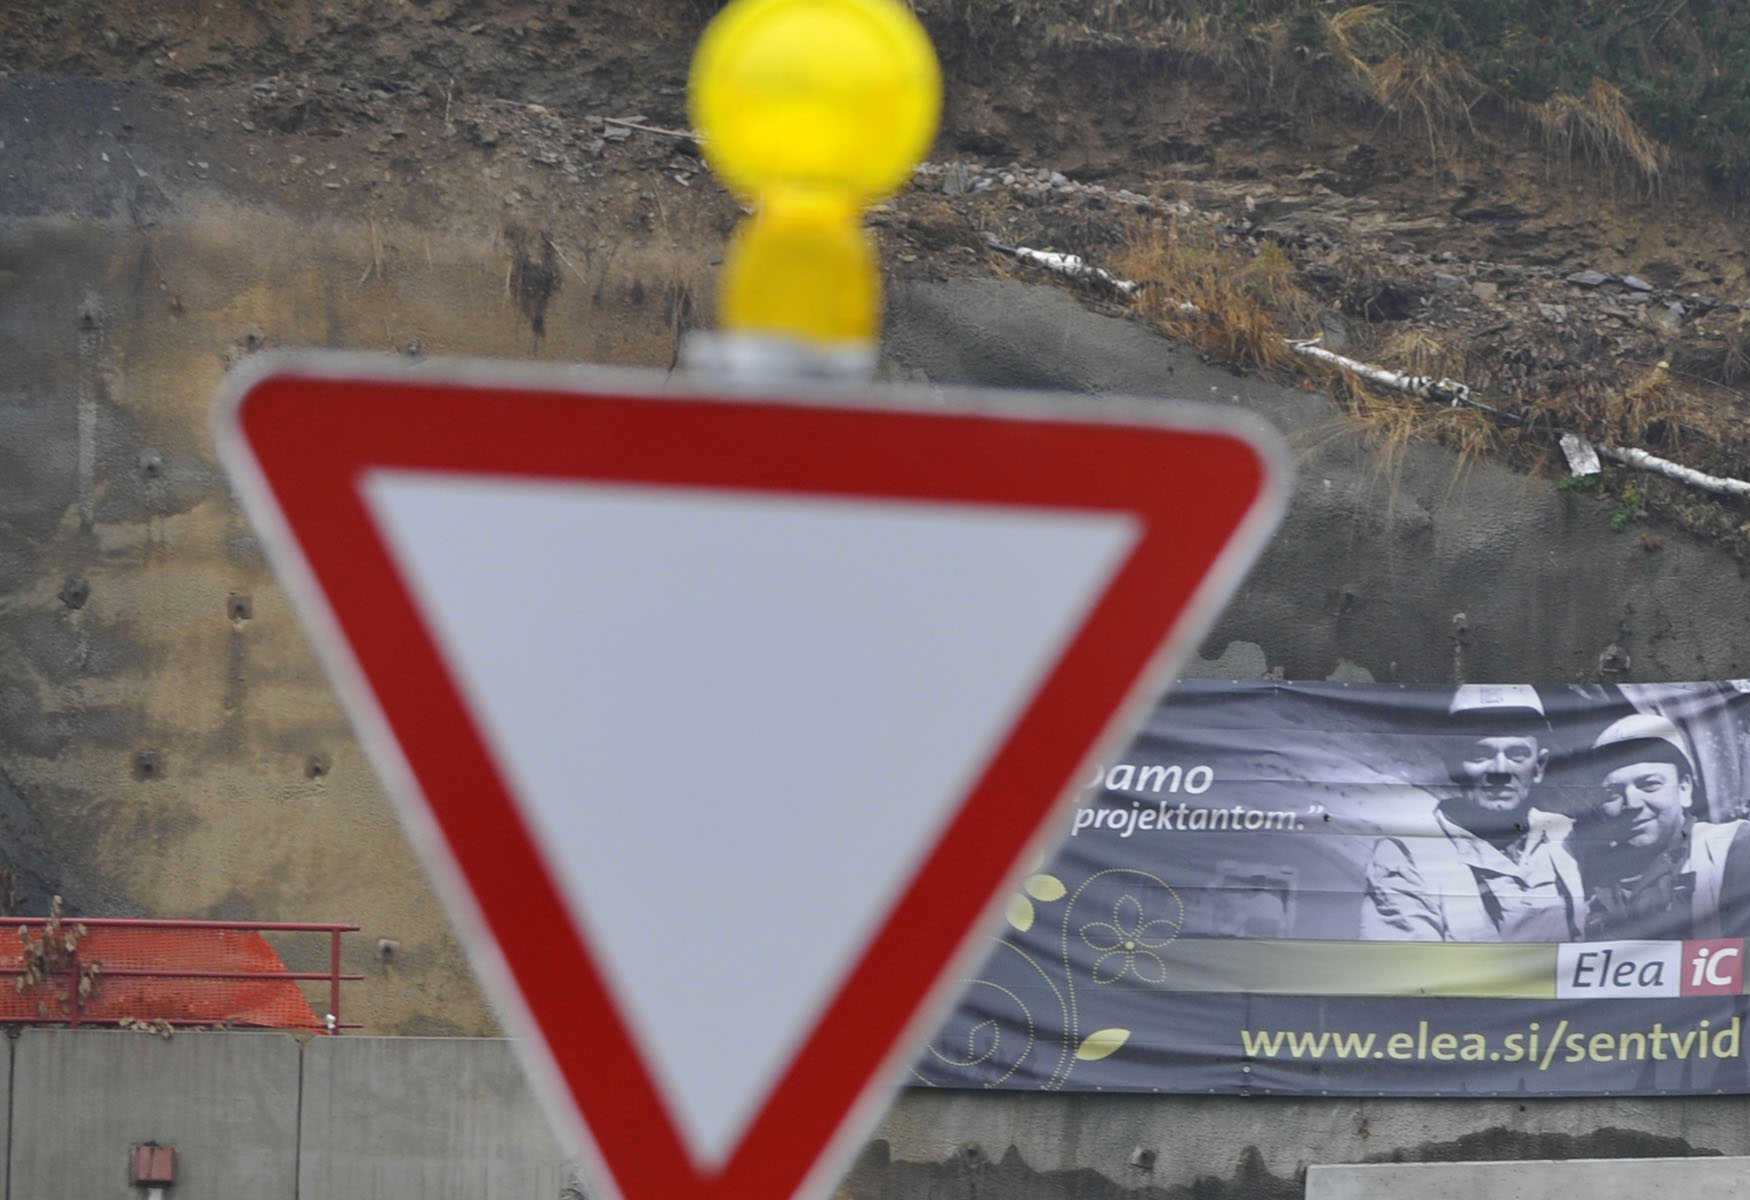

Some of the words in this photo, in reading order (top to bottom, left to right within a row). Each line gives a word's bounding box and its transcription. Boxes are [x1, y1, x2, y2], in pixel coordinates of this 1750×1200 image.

[1572, 951, 1664, 988] Elea
[1692, 947, 1739, 986] iC
[1241, 1017, 1741, 1070] www.elea.si/sentvid
